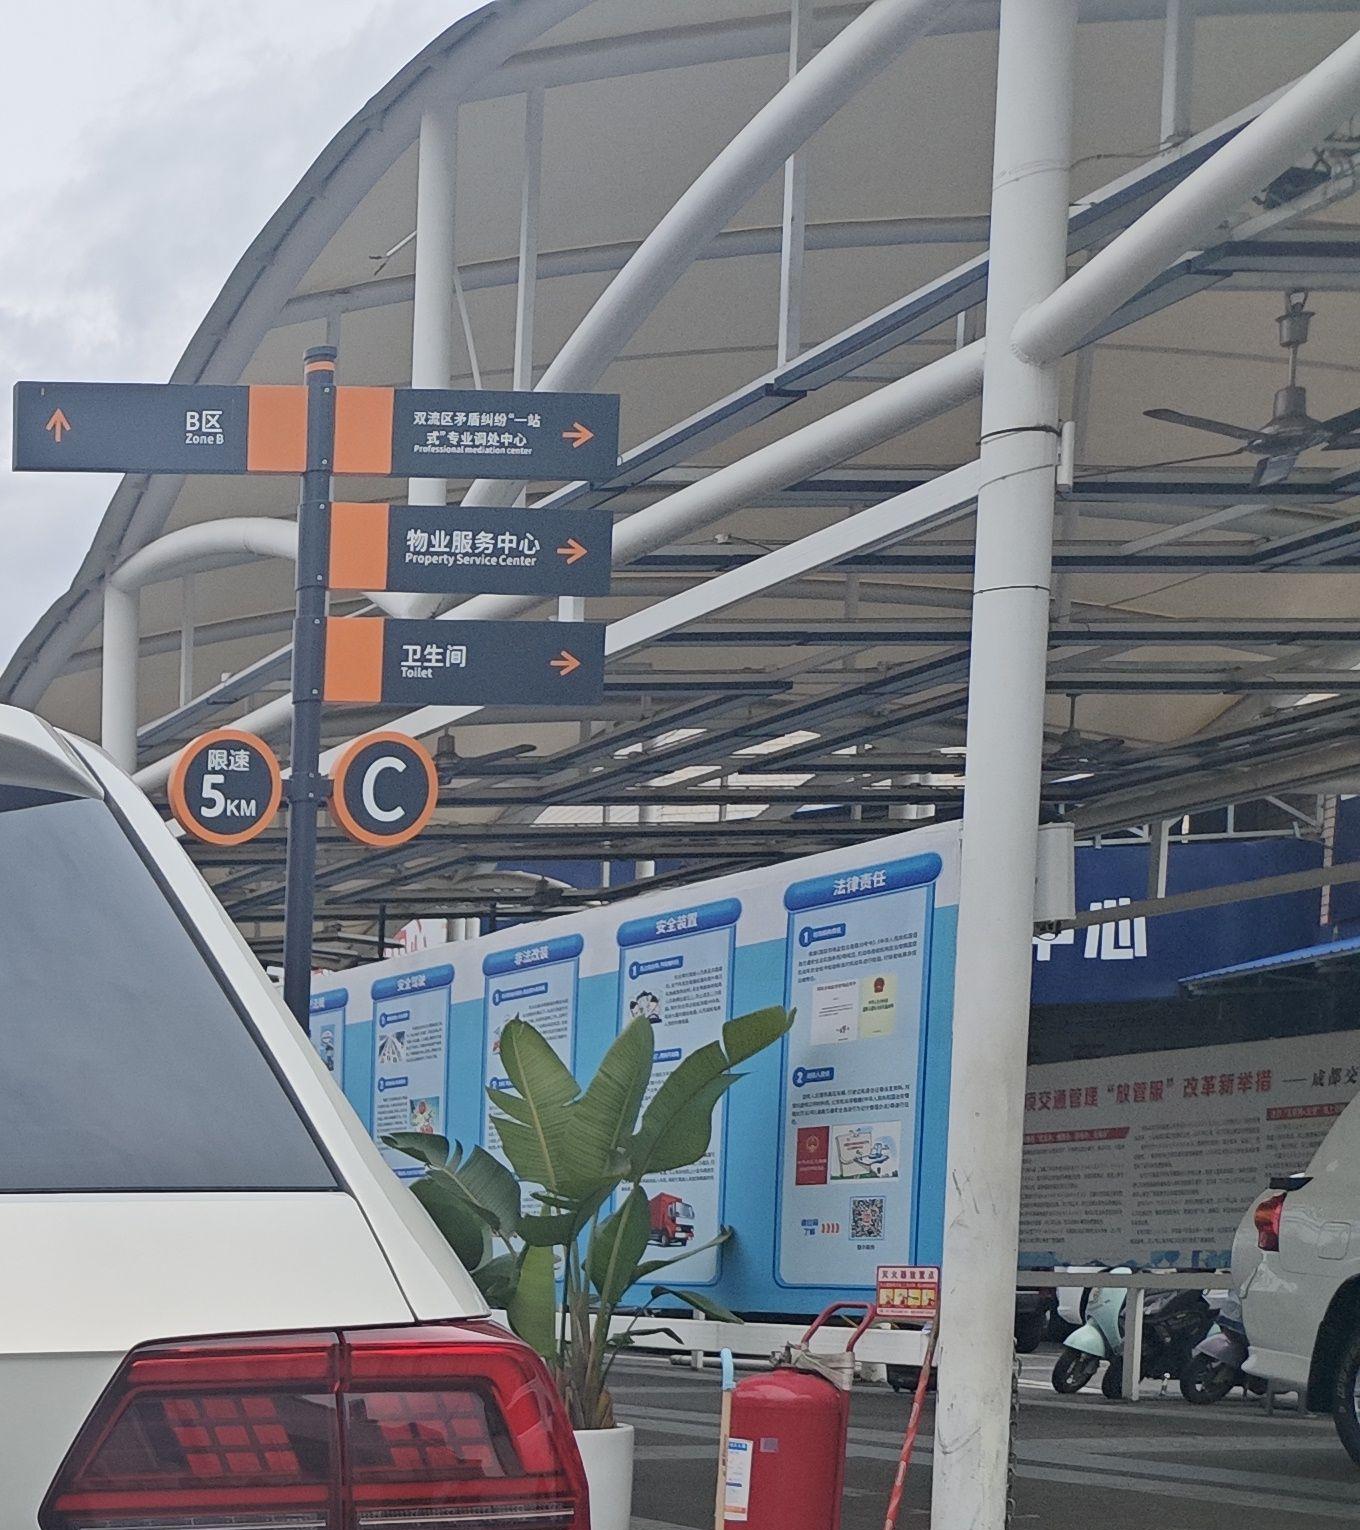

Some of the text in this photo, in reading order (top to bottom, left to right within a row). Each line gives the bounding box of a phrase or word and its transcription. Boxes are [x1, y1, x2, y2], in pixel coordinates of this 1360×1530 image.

[186, 410, 223, 432] B区
[185, 432, 224, 444] Zone B
[414, 445, 464, 454] Professional
[465, 446, 505, 454] mediation
[406, 529, 540, 554] 物业服务中心
[405, 553, 537, 567] Property Service Center
[400, 644, 467, 667] 卫生间
[401, 667, 433, 678] Toilet
[207, 749, 250, 771] 限速
[362, 756, 407, 822] C
[833, 870, 887, 896] 法律责任
